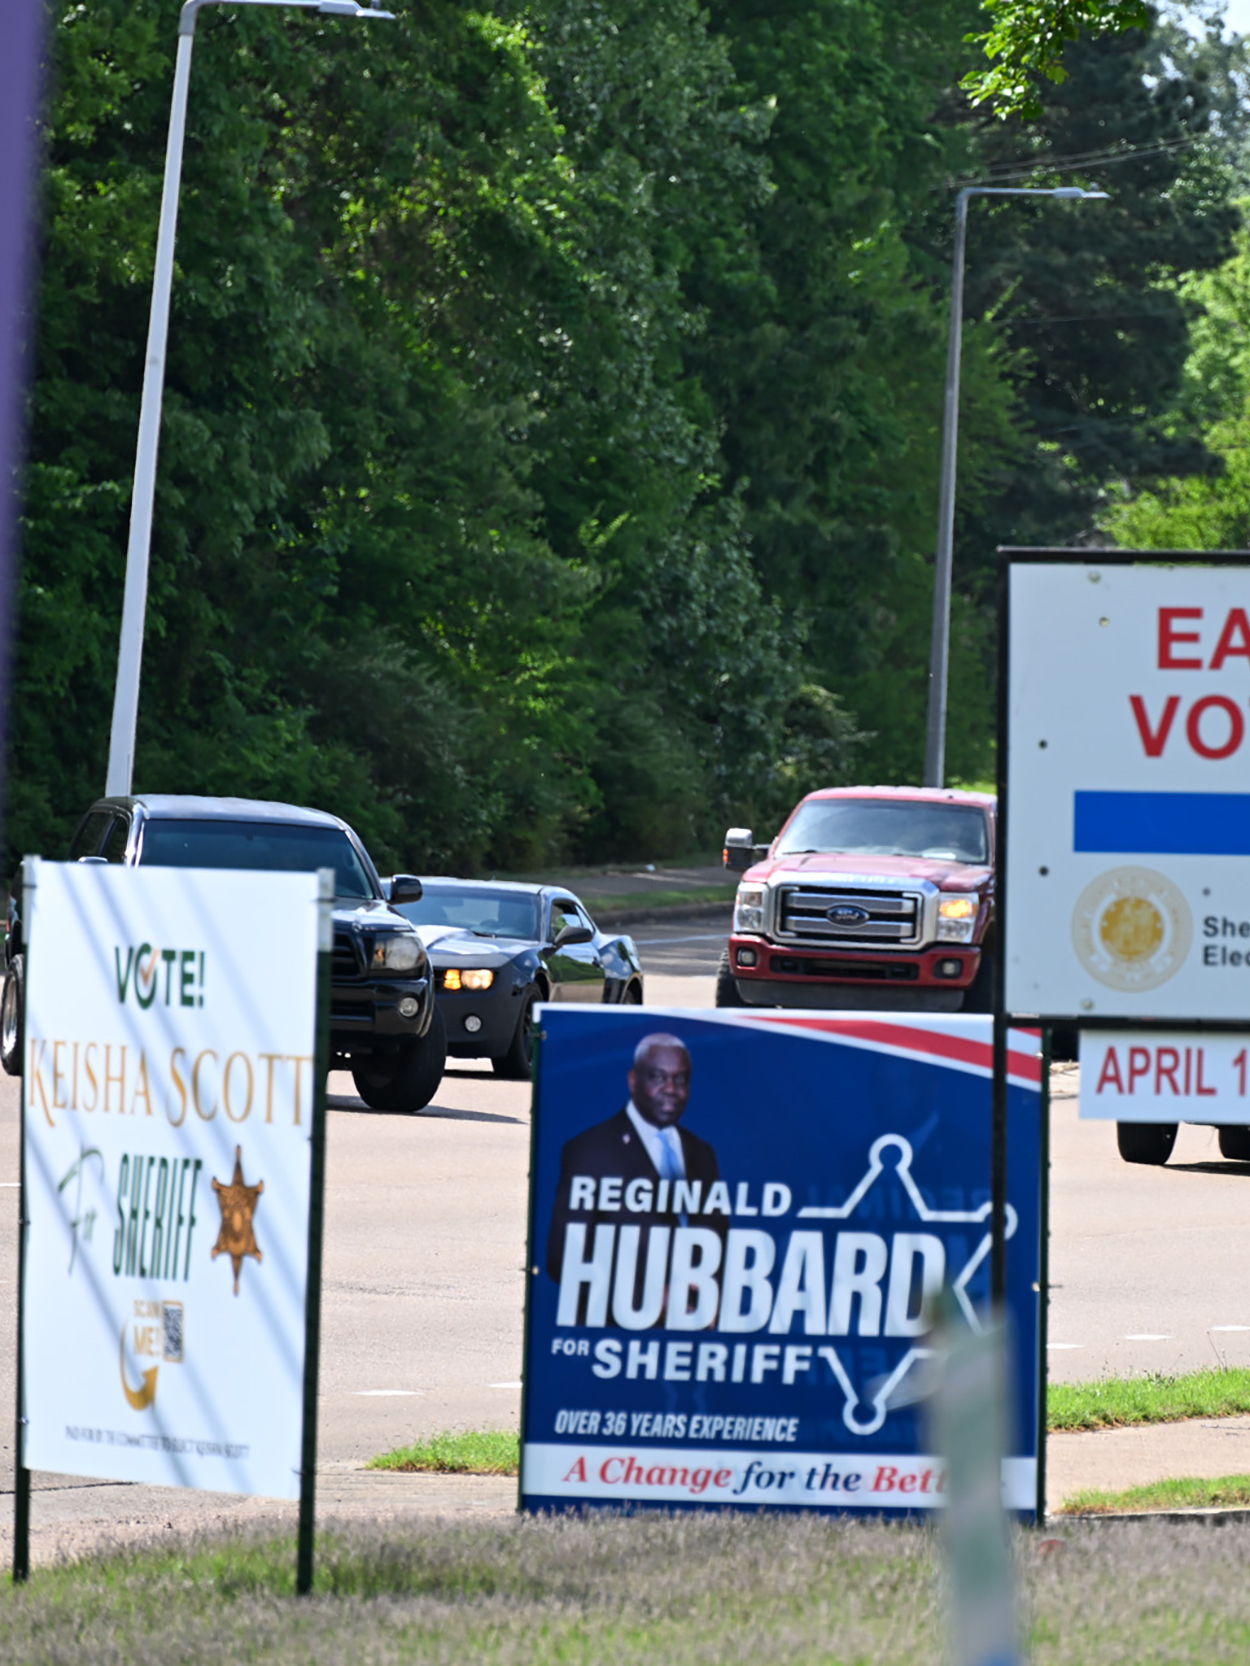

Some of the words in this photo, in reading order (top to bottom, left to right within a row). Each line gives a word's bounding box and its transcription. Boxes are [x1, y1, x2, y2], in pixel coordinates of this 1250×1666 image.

[114, 944, 205, 1009] VOTE!
[28, 1038, 153, 1128] KEISHA
[168, 1046, 313, 1129] SCOTT
[1097, 1046, 1217, 1096] APRIL
[113, 1153, 203, 1282] SHERIFF
[569, 1175, 792, 1218] REGINALD
[556, 1223, 946, 1337] HUBBARD
[551, 1338, 590, 1357] FOR
[592, 1339, 813, 1385] SHERIFF
[554, 1409, 601, 1435] OVER
[602, 1411, 628, 1437] 36
[630, 1412, 686, 1439] YEARS
[687, 1414, 799, 1443] EXPERIENCE
[562, 1456, 589, 1484] A
[599, 1456, 732, 1493] Change
[733, 1461, 797, 1495] for
[805, 1464, 862, 1492] the
